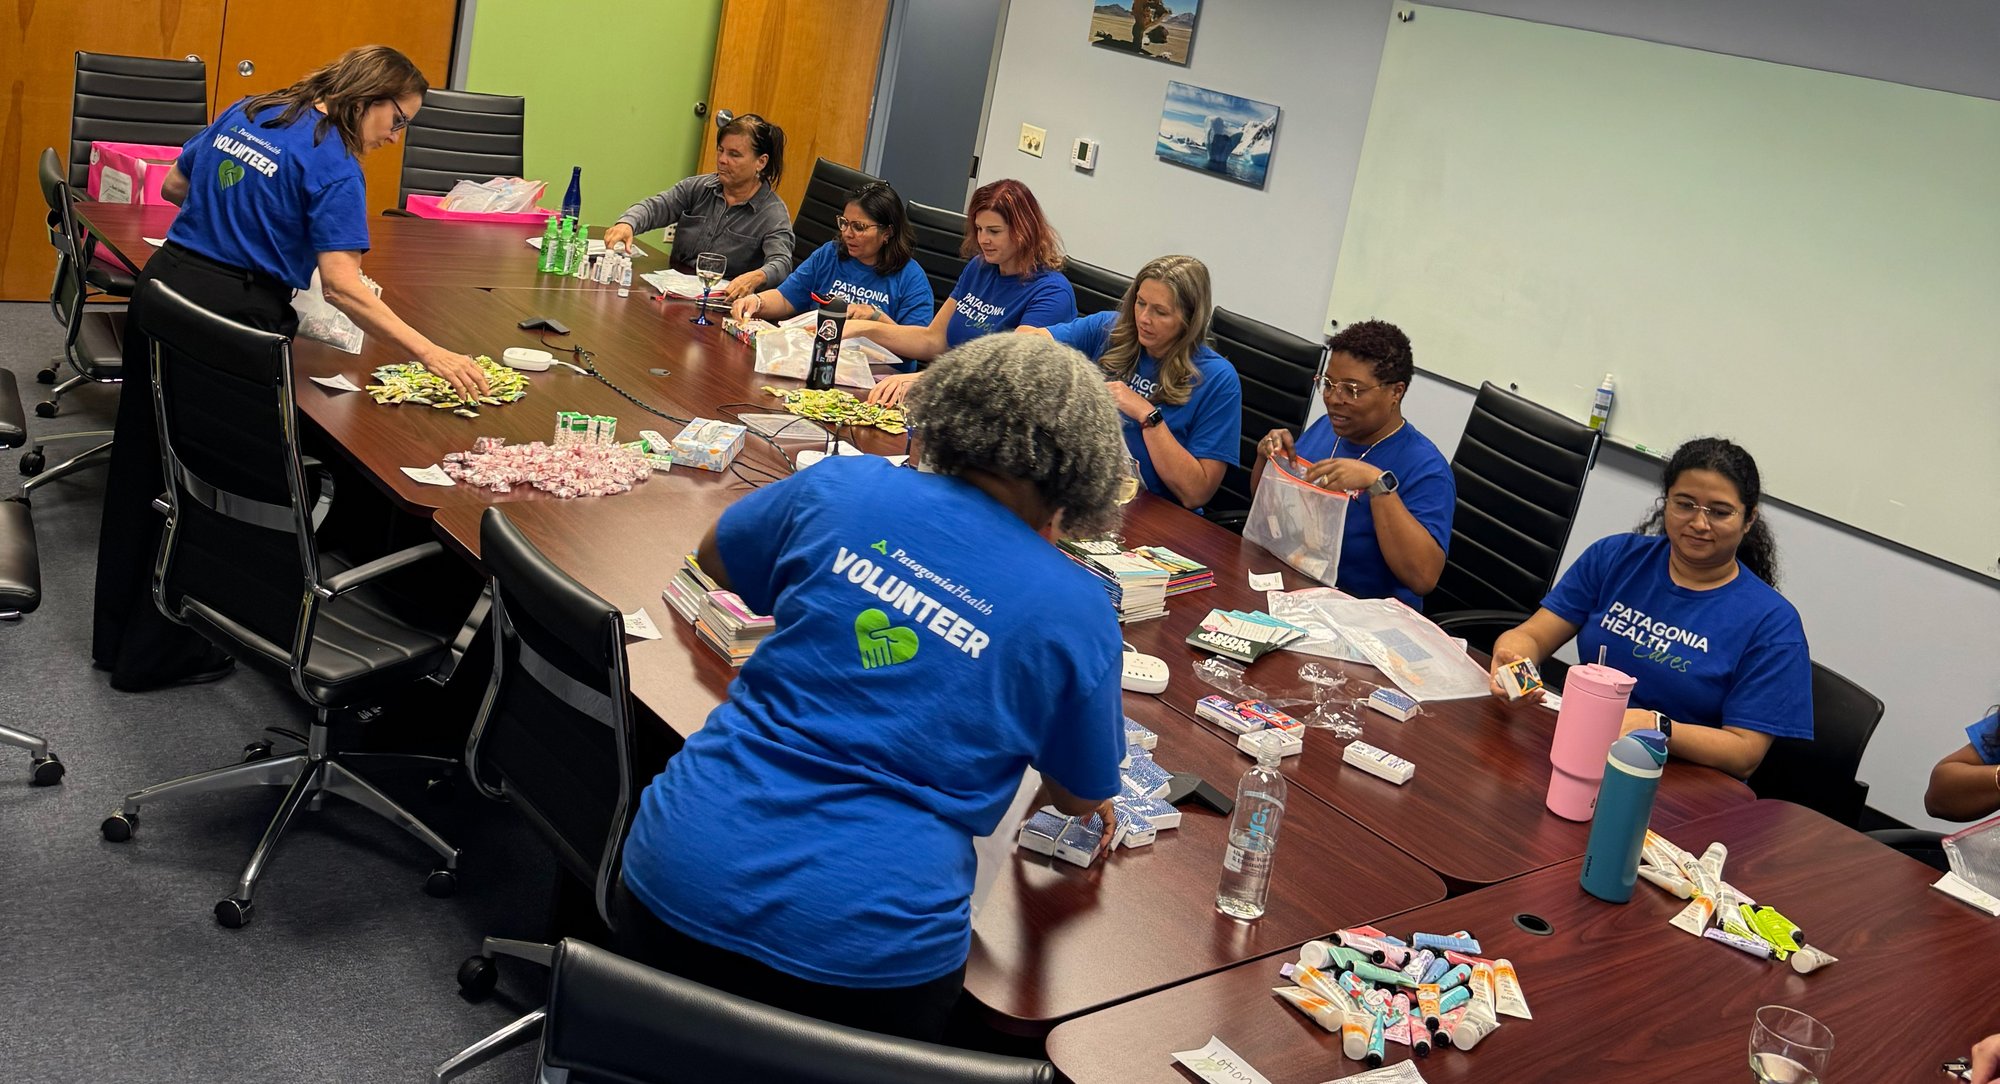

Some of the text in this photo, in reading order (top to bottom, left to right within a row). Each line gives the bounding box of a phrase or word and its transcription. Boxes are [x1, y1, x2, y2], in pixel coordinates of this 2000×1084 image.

[212, 133, 279, 178] VOLUNTEER
[832, 279, 889, 305] PATAGONIA
[963, 292, 1006, 316] PATAGONIA
[956, 300, 988, 323] HEALTH
[831, 546, 990, 659] VOLUNTEER
[1600, 614, 1671, 653] HEALTH
[1608, 600, 1708, 653] PATAGONIA
[1632, 639, 1692, 672] Cares
[1207, 1051, 1253, 1084] Lotion
